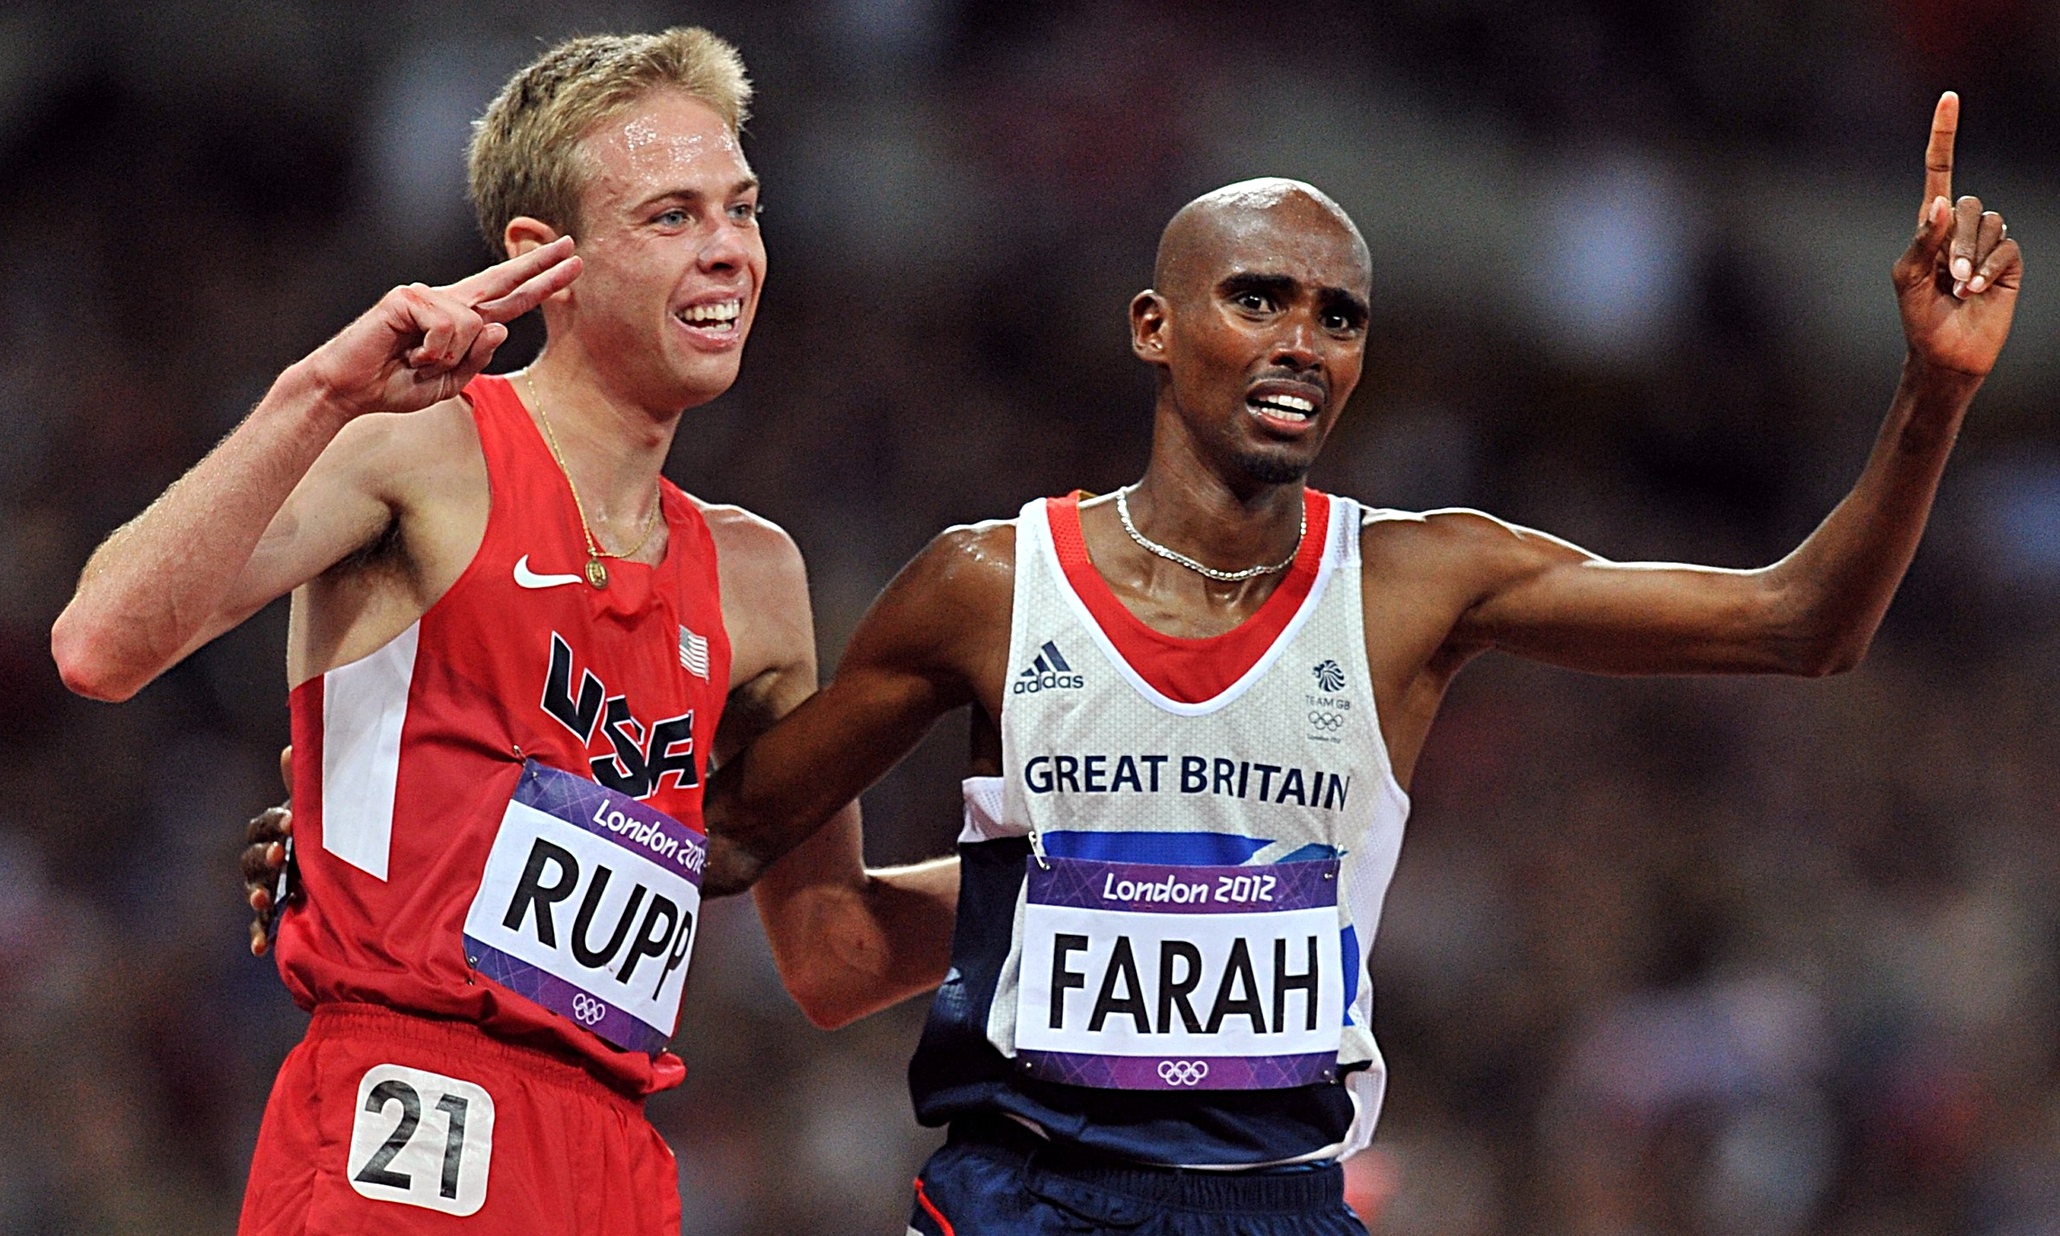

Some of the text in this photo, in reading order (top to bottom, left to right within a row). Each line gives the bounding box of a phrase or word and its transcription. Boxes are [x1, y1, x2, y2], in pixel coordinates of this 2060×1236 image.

[1013, 670, 1084, 694] adidas
[1305, 694, 1351, 711] TEAM GB
[540, 630, 700, 801] USA
[1024, 755, 1351, 812] GREAT BRITAIN
[592, 798, 679, 859] London
[502, 836, 694, 1001] RUPP
[1102, 872, 1277, 904] London 2012
[1049, 932, 1318, 1035] FARAH
[353, 1079, 469, 1200] 21
